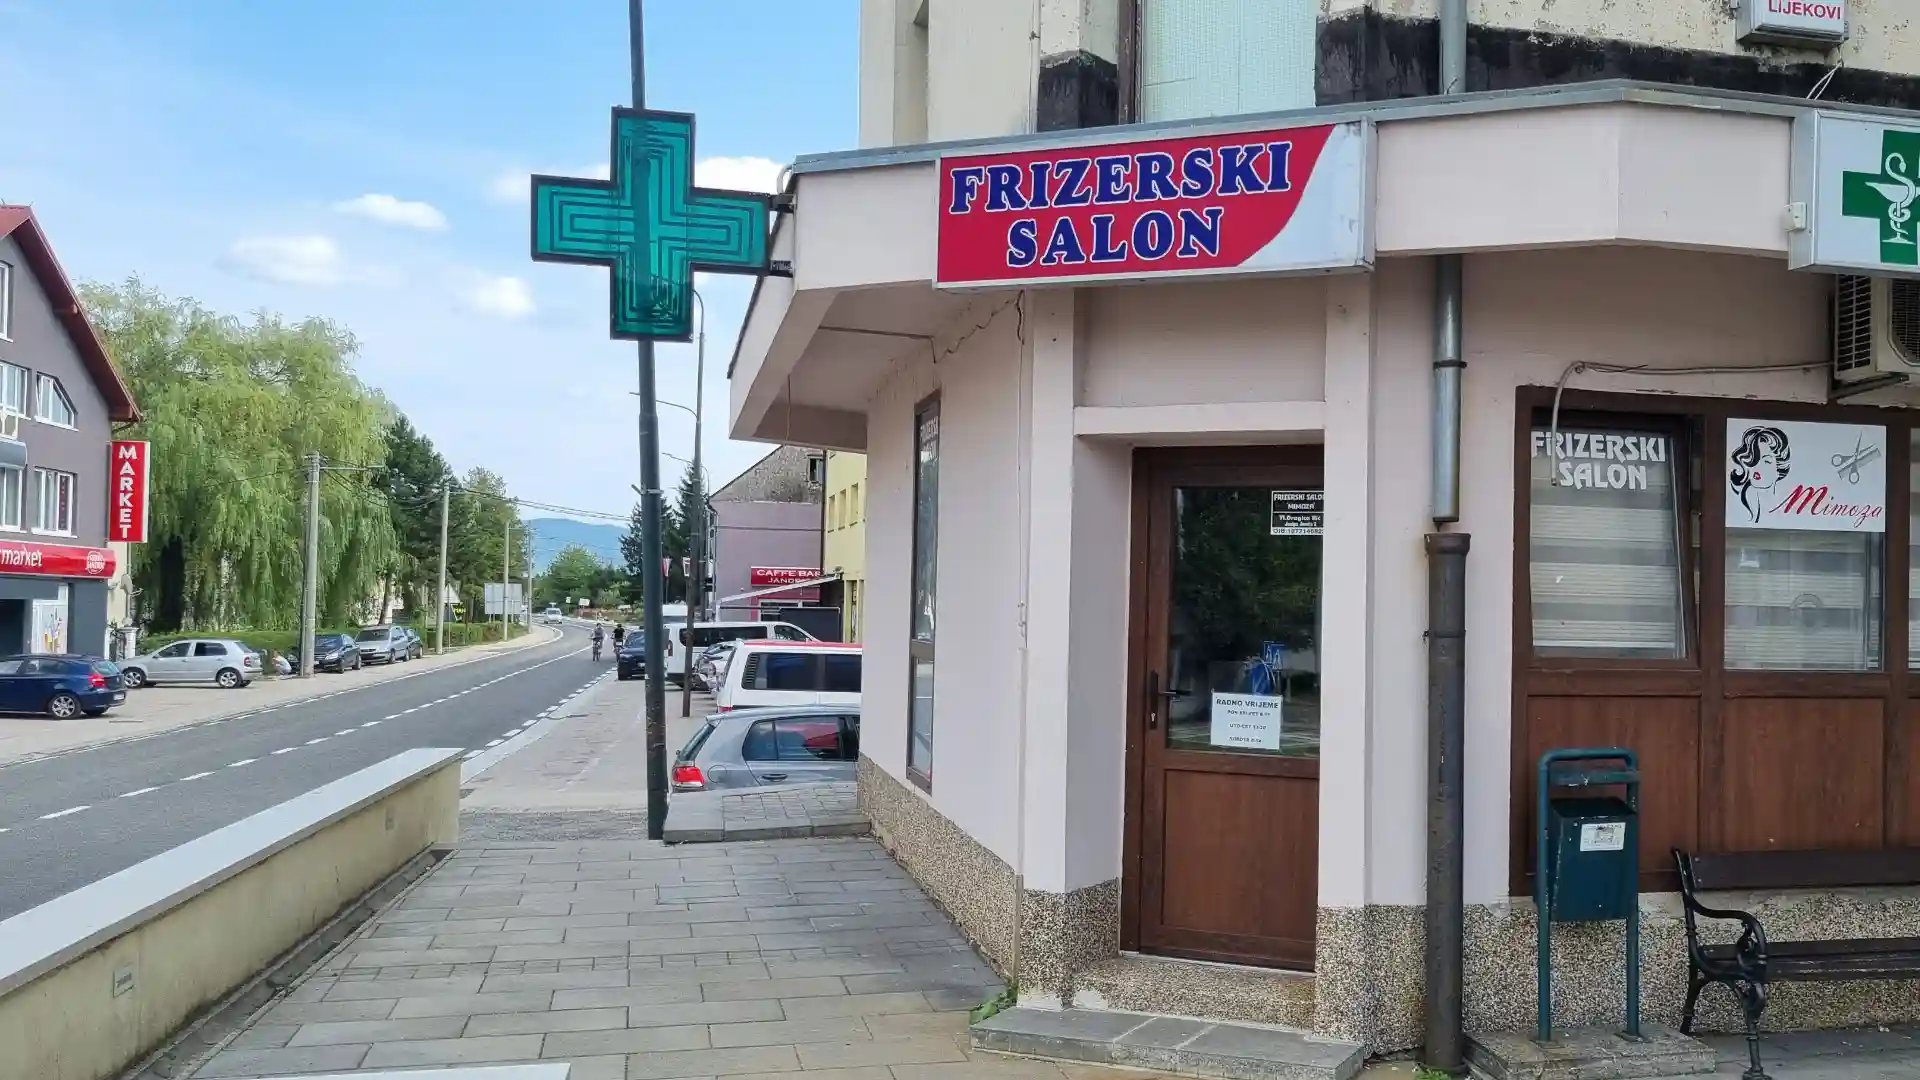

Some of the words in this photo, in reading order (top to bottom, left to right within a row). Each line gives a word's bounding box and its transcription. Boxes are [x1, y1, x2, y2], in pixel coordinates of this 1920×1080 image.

[1768, 0, 1841, 20] LIJEKOVI
[949, 141, 1292, 215] FRIZERSKI
[1006, 207, 1224, 268] SALON
[1531, 431, 1666, 462] FRIZERSKI
[118, 445, 138, 539] MARKET
[1559, 462, 1647, 490] SALON
[1769, 485, 1883, 528] Mimoza
